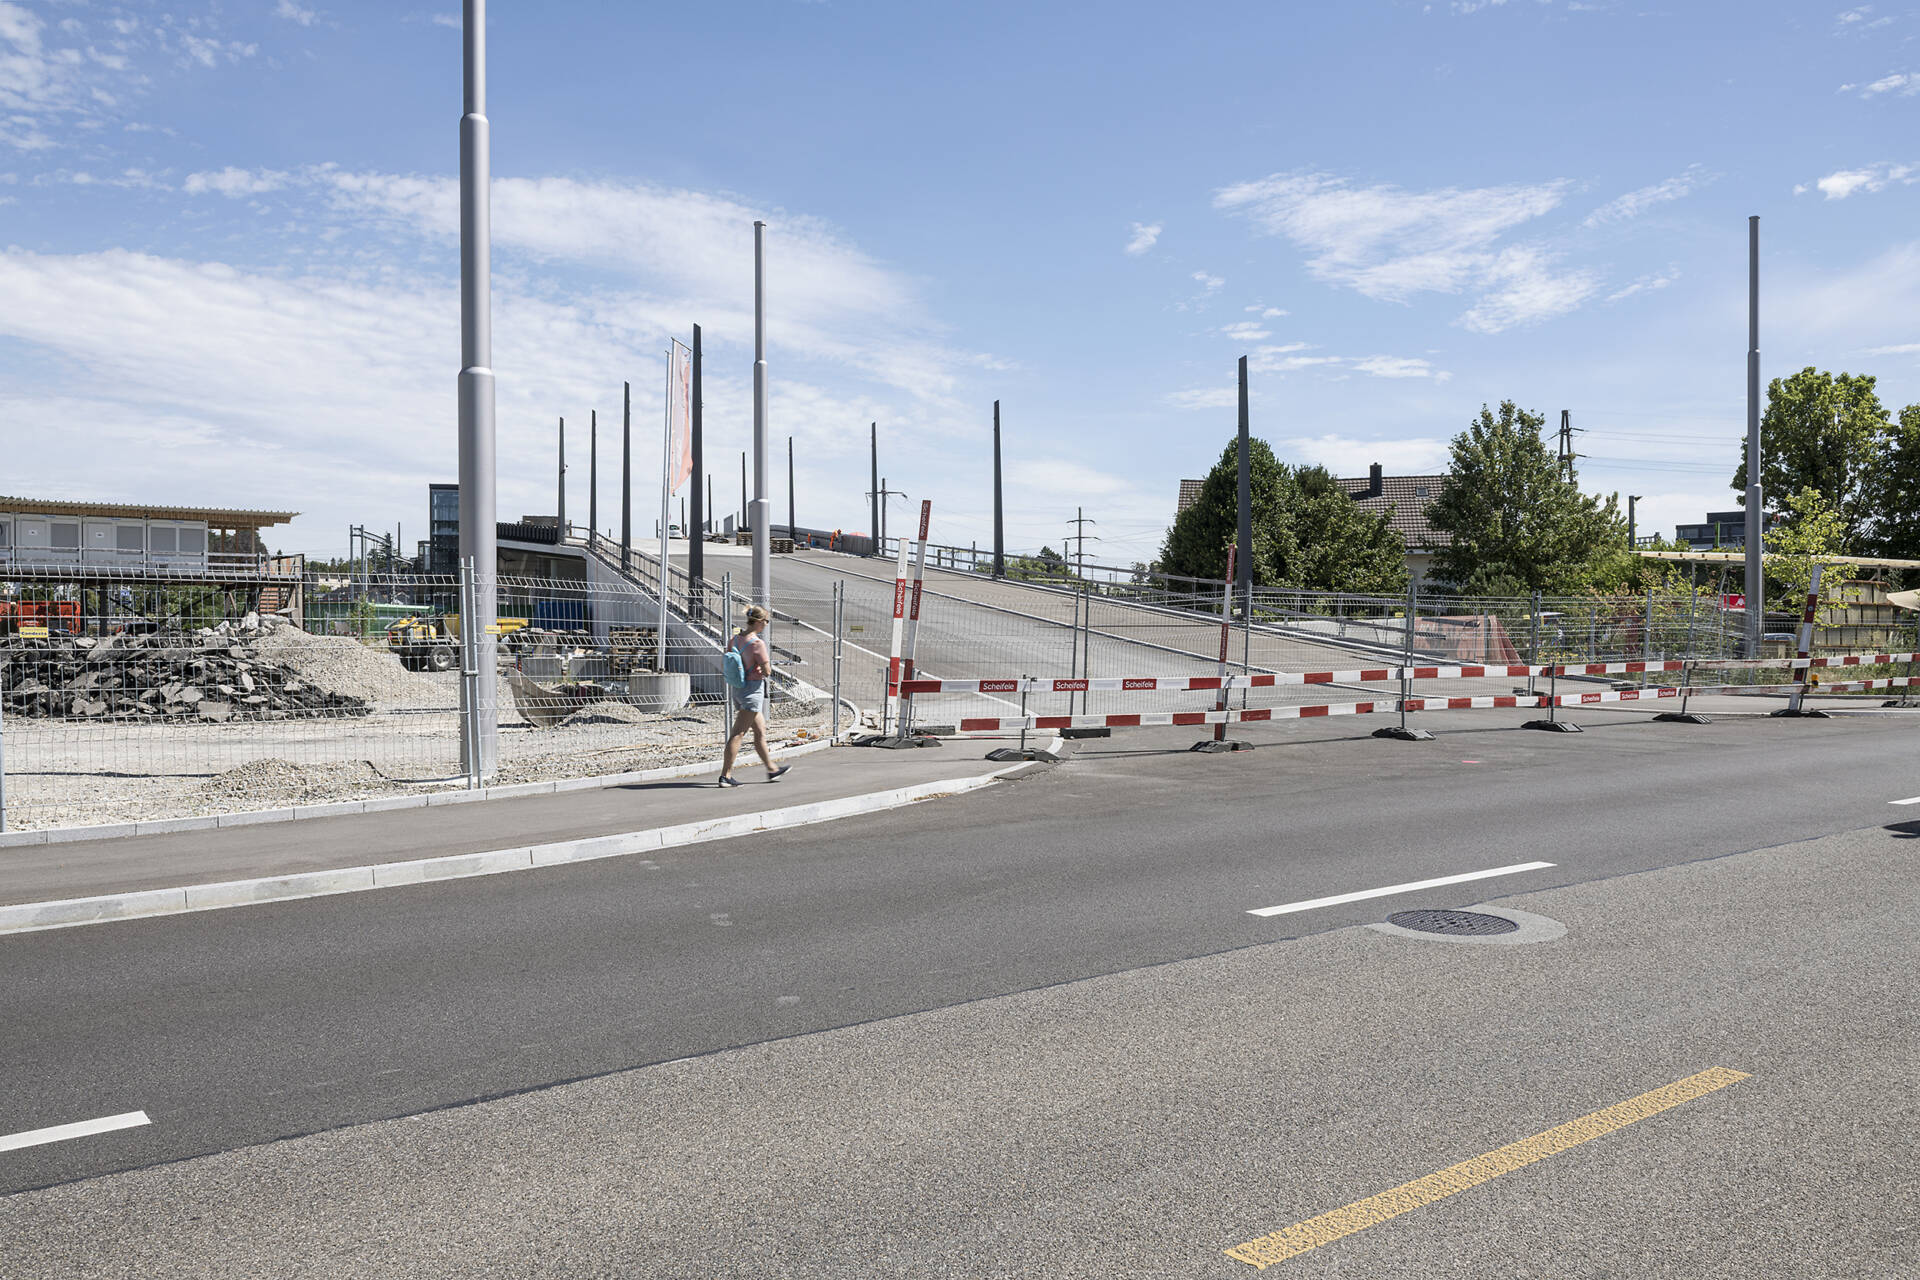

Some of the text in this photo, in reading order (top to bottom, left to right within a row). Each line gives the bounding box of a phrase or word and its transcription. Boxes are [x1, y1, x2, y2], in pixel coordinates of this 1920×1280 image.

[896, 582, 904, 615] Scheifele
[1056, 682, 1087, 690] Scheifele
[1125, 681, 1154, 689] Scheifele
